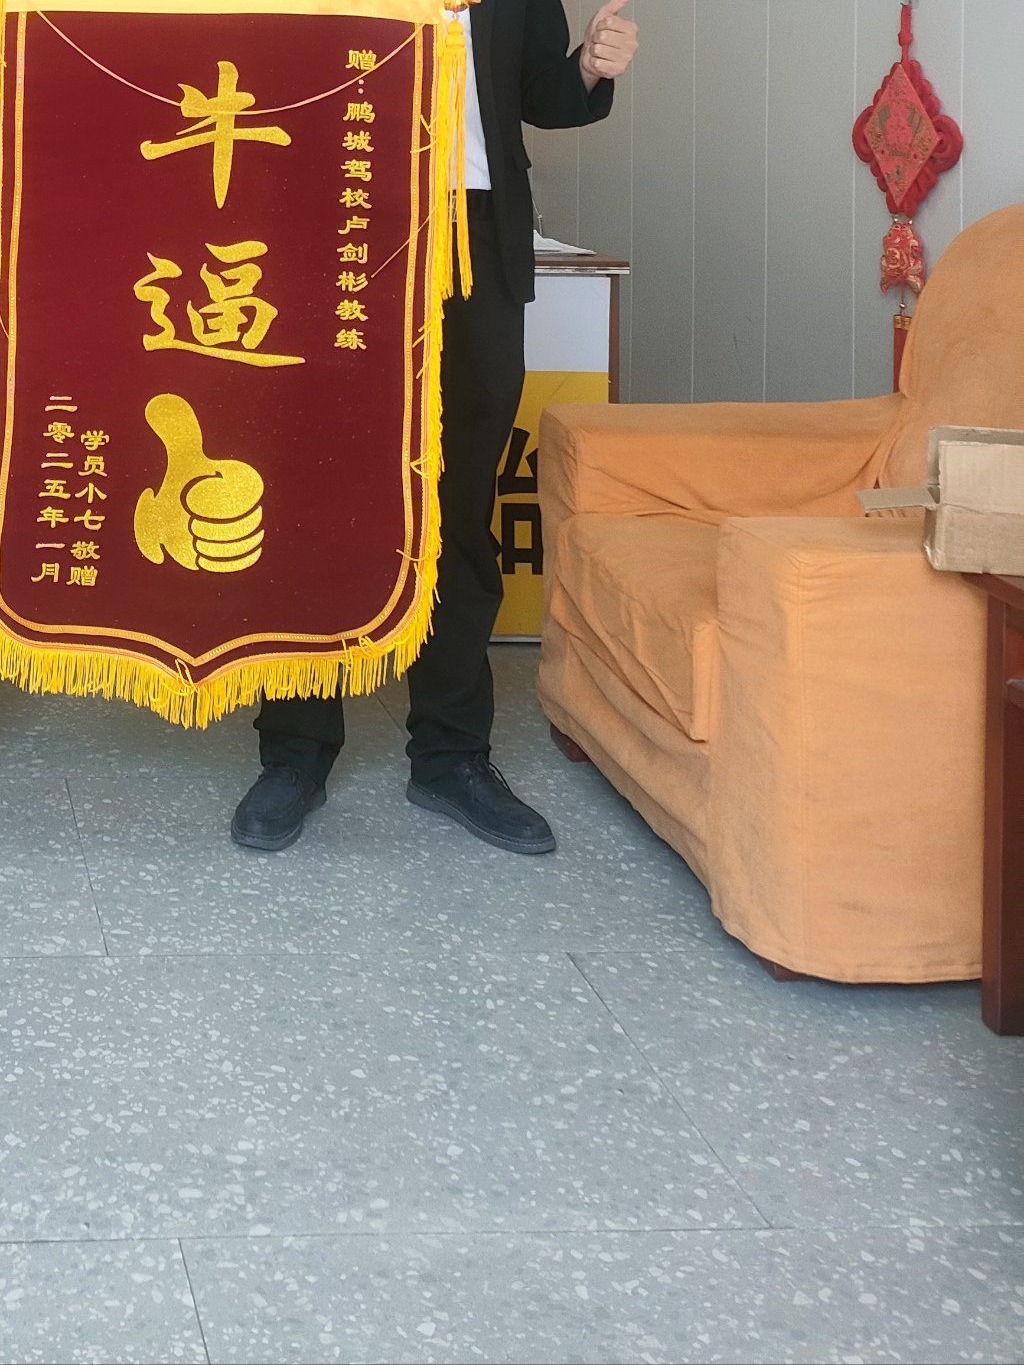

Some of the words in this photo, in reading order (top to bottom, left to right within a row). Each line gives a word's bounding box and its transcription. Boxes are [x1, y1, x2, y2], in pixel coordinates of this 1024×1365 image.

[133, 60, 306, 368] 牛逼
[30, 395, 79, 585] 二零二五年一月
